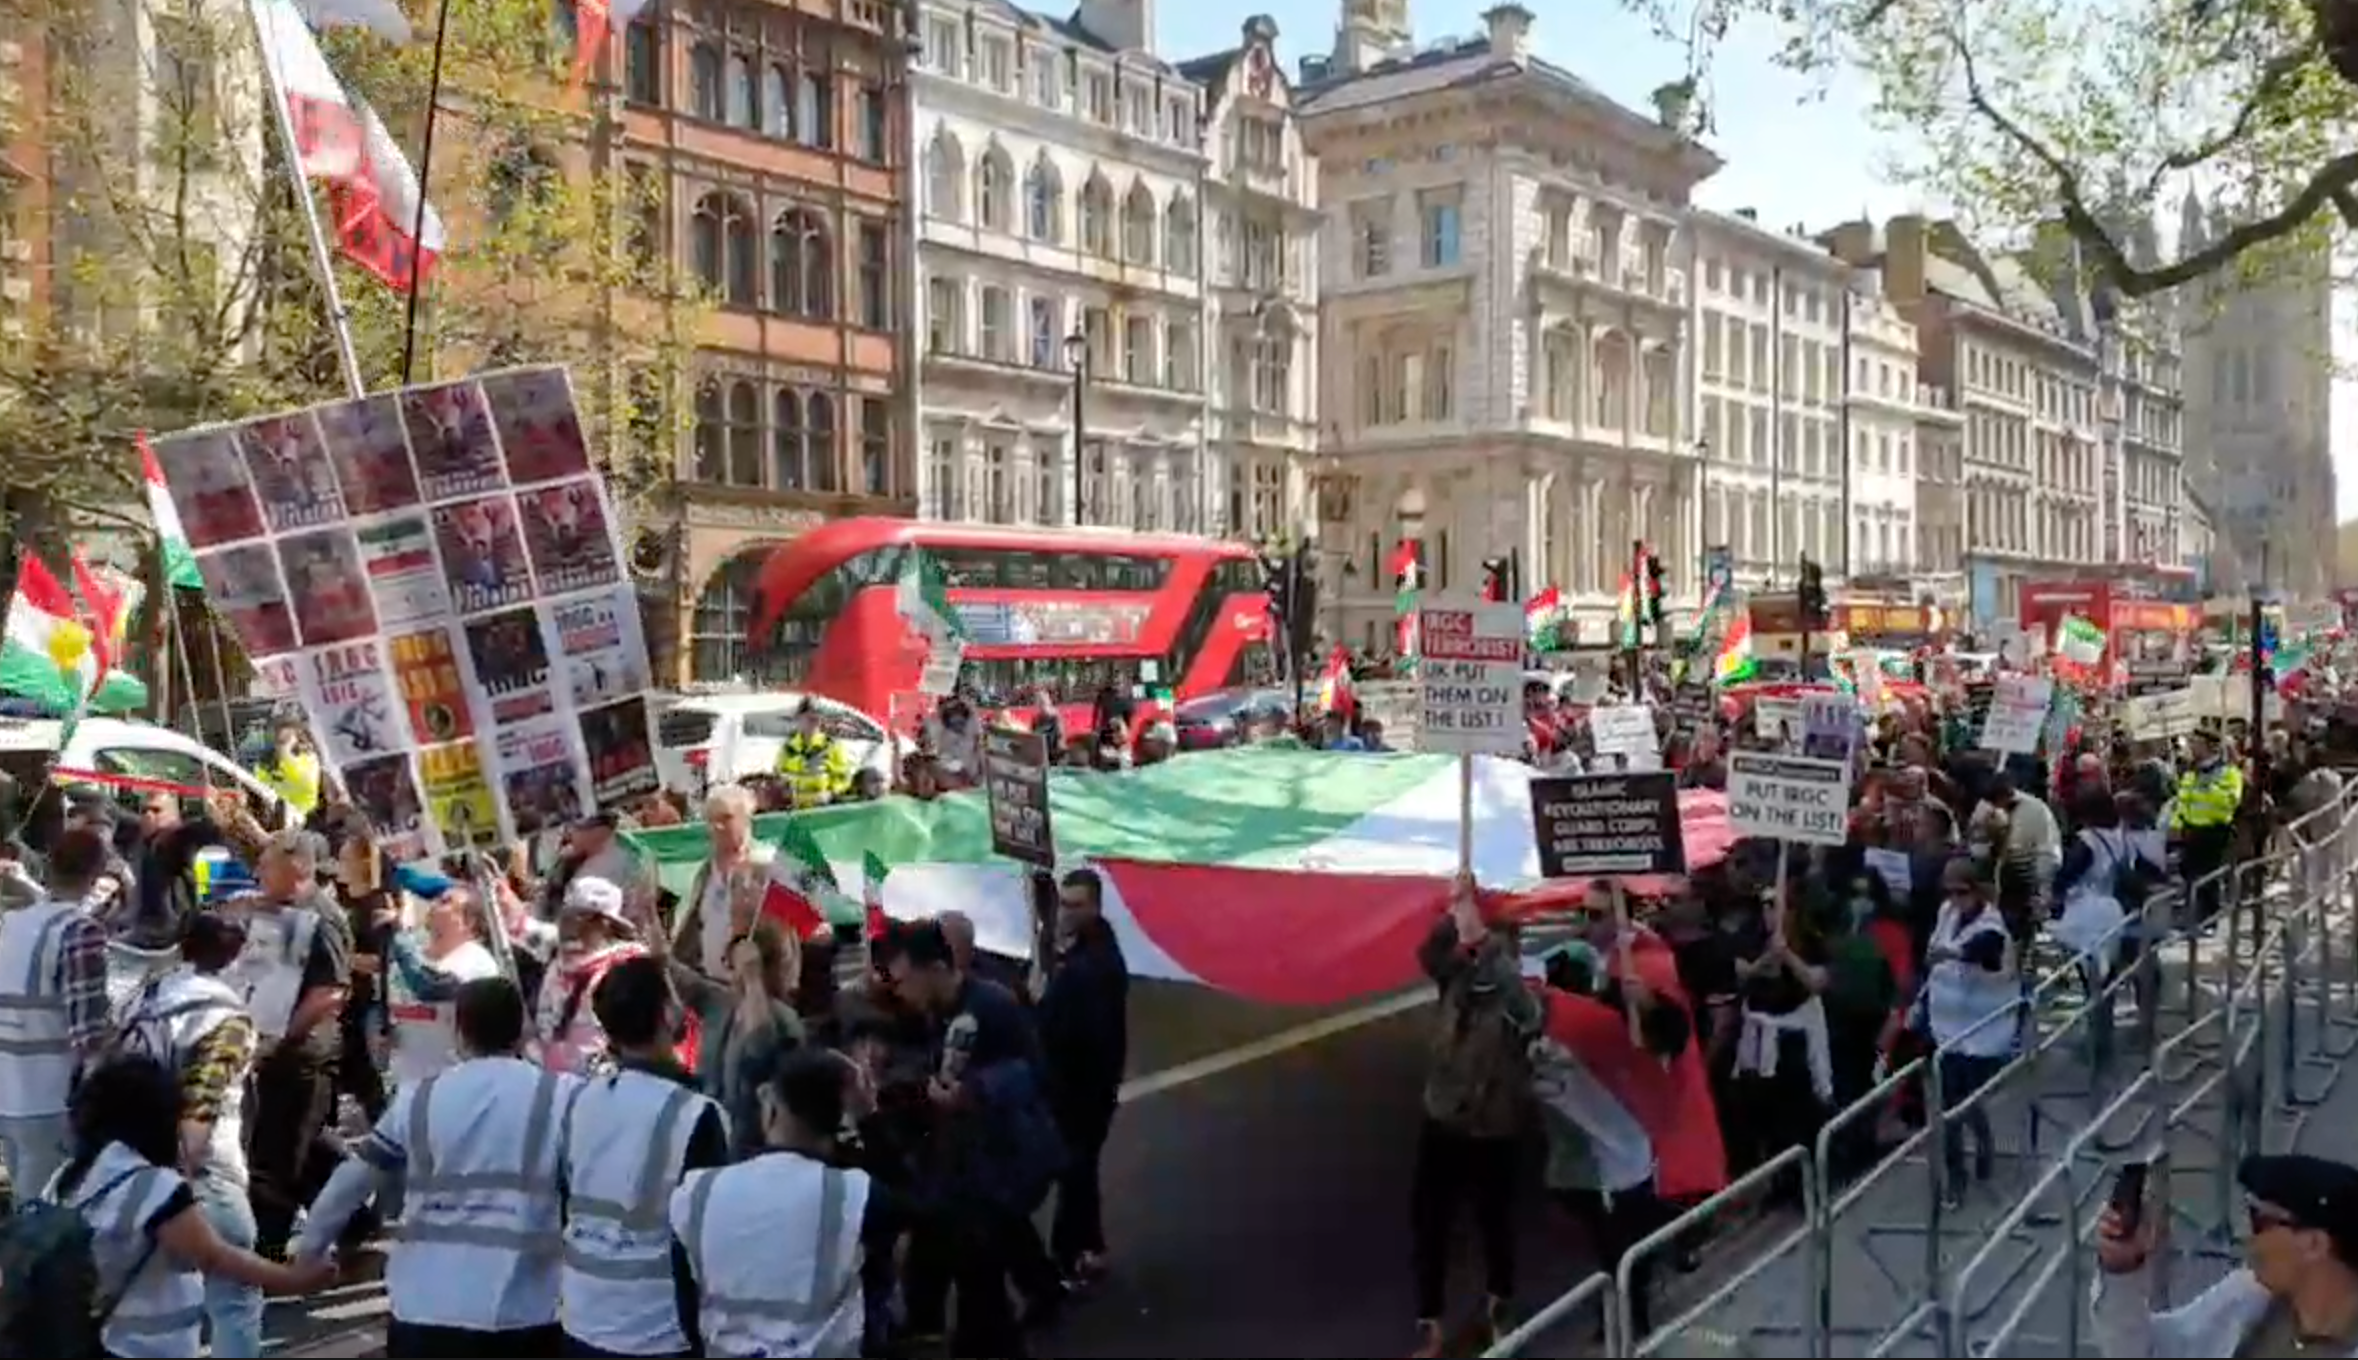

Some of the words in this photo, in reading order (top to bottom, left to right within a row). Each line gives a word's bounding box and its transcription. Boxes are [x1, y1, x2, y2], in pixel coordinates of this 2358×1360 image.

[1424, 612, 1470, 634] IRGC
[1425, 662, 1449, 678] UK
[1455, 663, 1486, 680] PUT
[1425, 686, 1472, 703] THEM
[1478, 687, 1508, 704] ON
[1425, 710, 1453, 727] THE
[1572, 781, 1627, 799] ISLAMIC
[1745, 780, 1777, 800] PUT
[1783, 785, 1829, 806] IRGC
[1729, 801, 1760, 822] ON
[1766, 806, 1799, 826] THE
